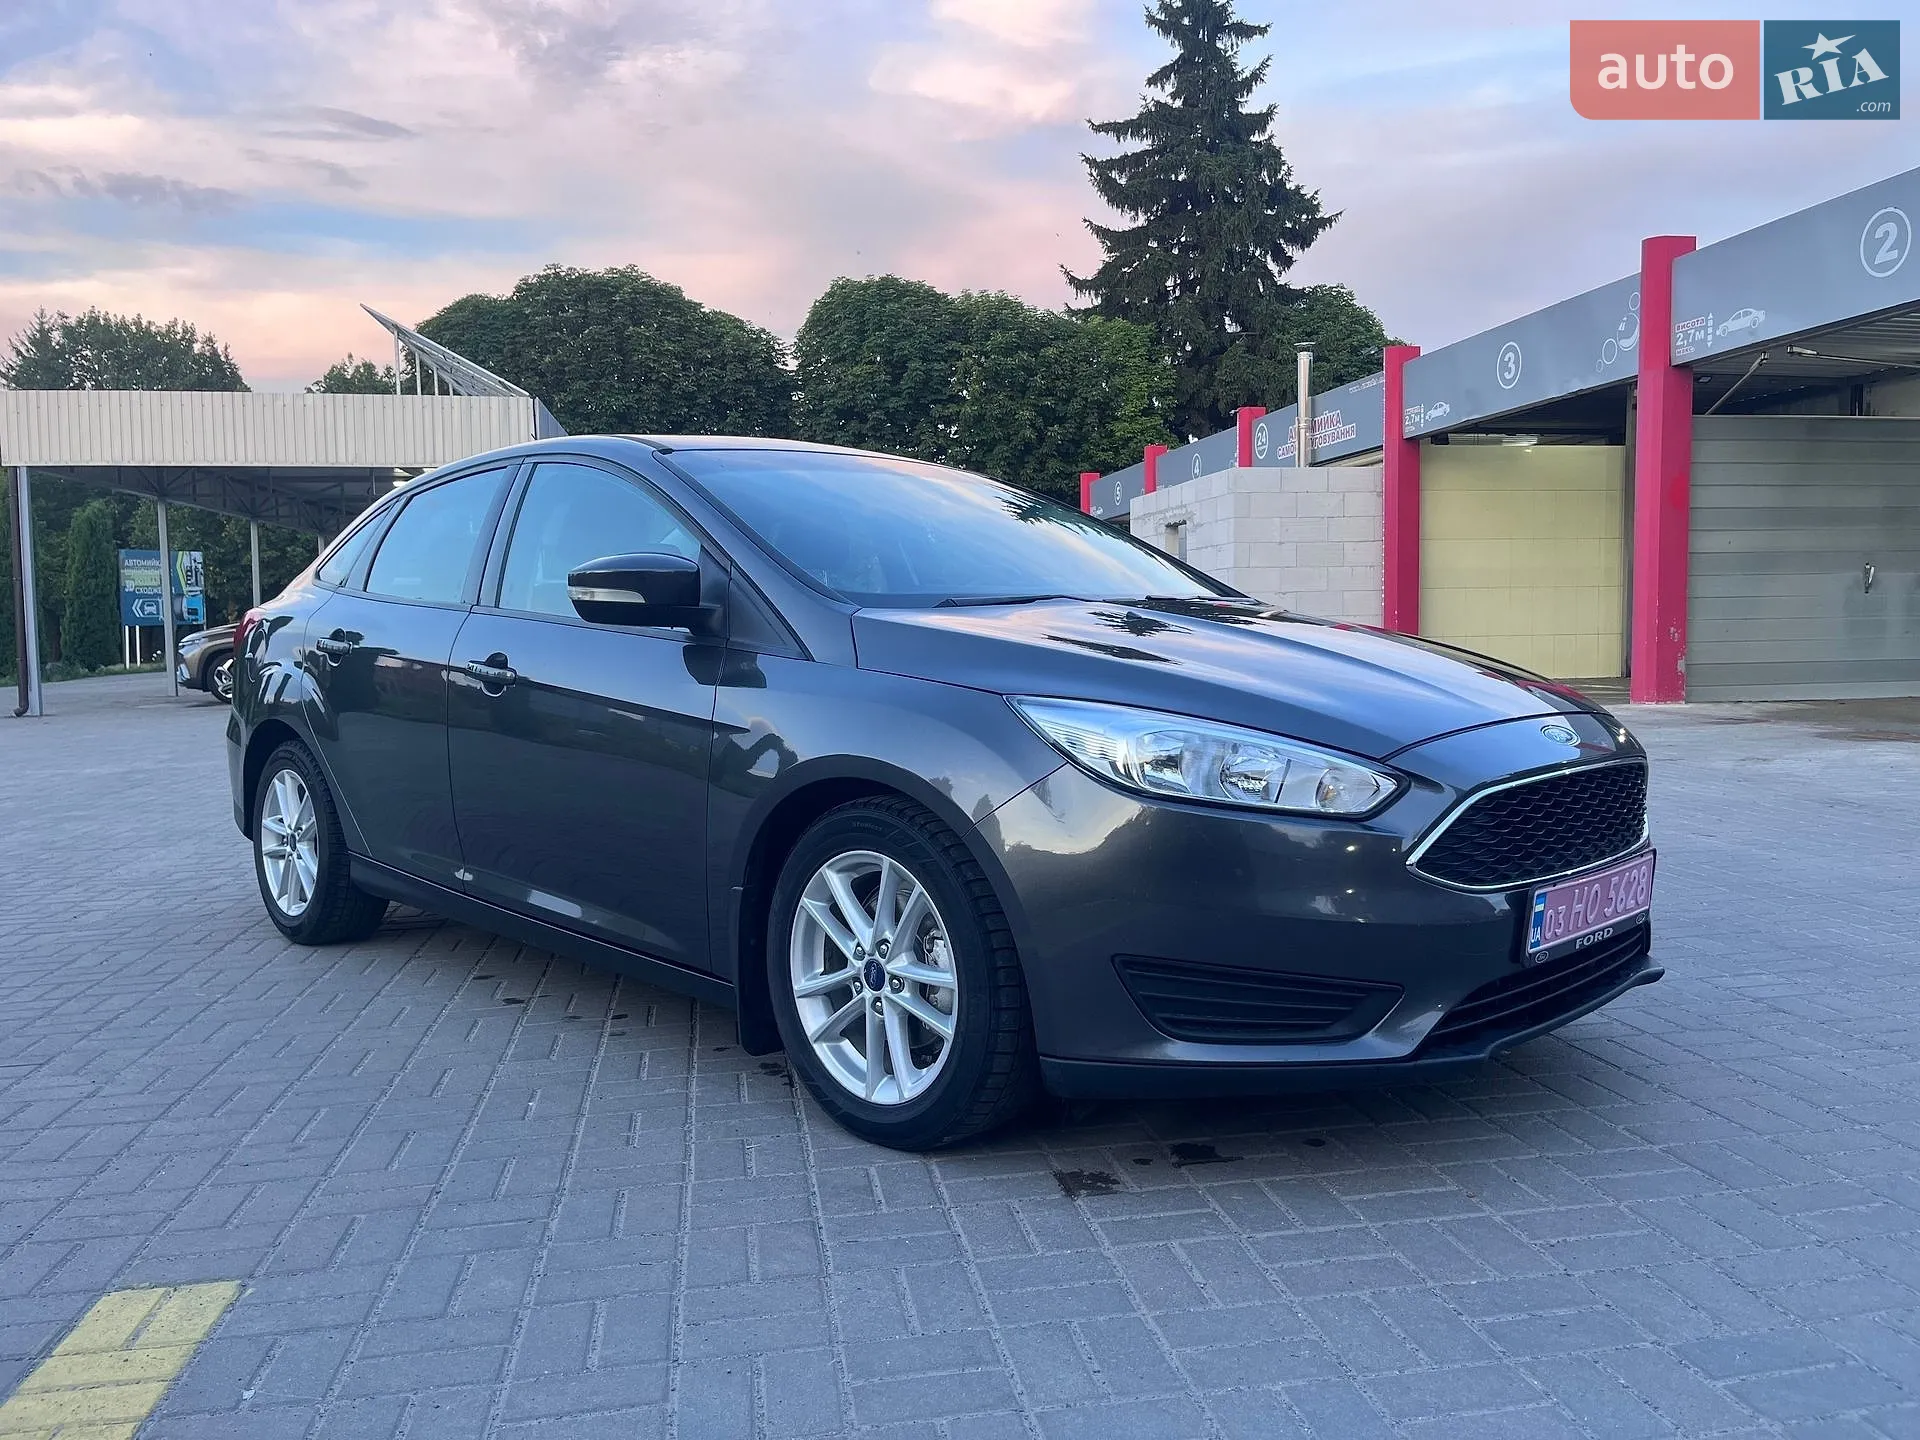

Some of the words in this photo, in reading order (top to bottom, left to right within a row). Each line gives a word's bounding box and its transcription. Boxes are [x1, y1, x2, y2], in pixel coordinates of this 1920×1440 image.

[1873, 221, 1899, 266] 2
[1675, 317, 1706, 333] ВИСОТА
[1502, 350, 1516, 380] 3
[1257, 429, 1267, 447] 24
[1544, 905, 1566, 939] 03
[1603, 865, 1648, 917] 5628
[1531, 926, 1541, 943] UA
[1575, 926, 1614, 950] FORD
